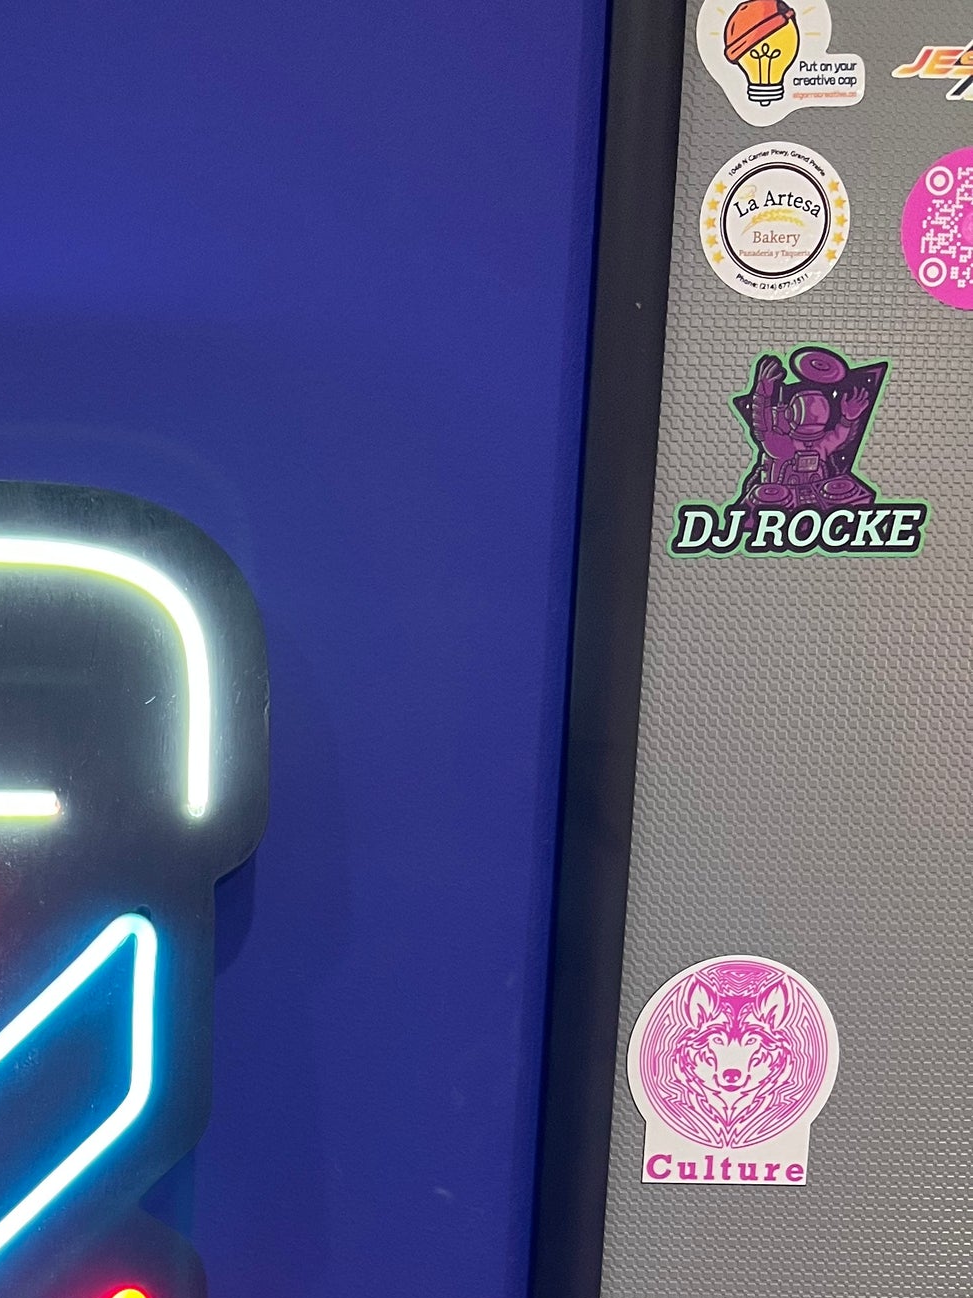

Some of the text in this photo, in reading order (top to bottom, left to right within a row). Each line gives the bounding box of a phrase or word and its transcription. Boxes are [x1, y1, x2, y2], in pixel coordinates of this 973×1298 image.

[799, 60, 858, 74] Put on your
[792, 74, 858, 88] creative cap
[790, 150, 811, 163] Grand
[733, 189, 821, 218] La Artesa
[752, 230, 801, 247] Bakery
[735, 273, 758, 288] Phone:
[759, 282, 777, 290] (214)
[677, 509, 921, 548] DJ ROCKE
[646, 1154, 805, 1182] Culture
